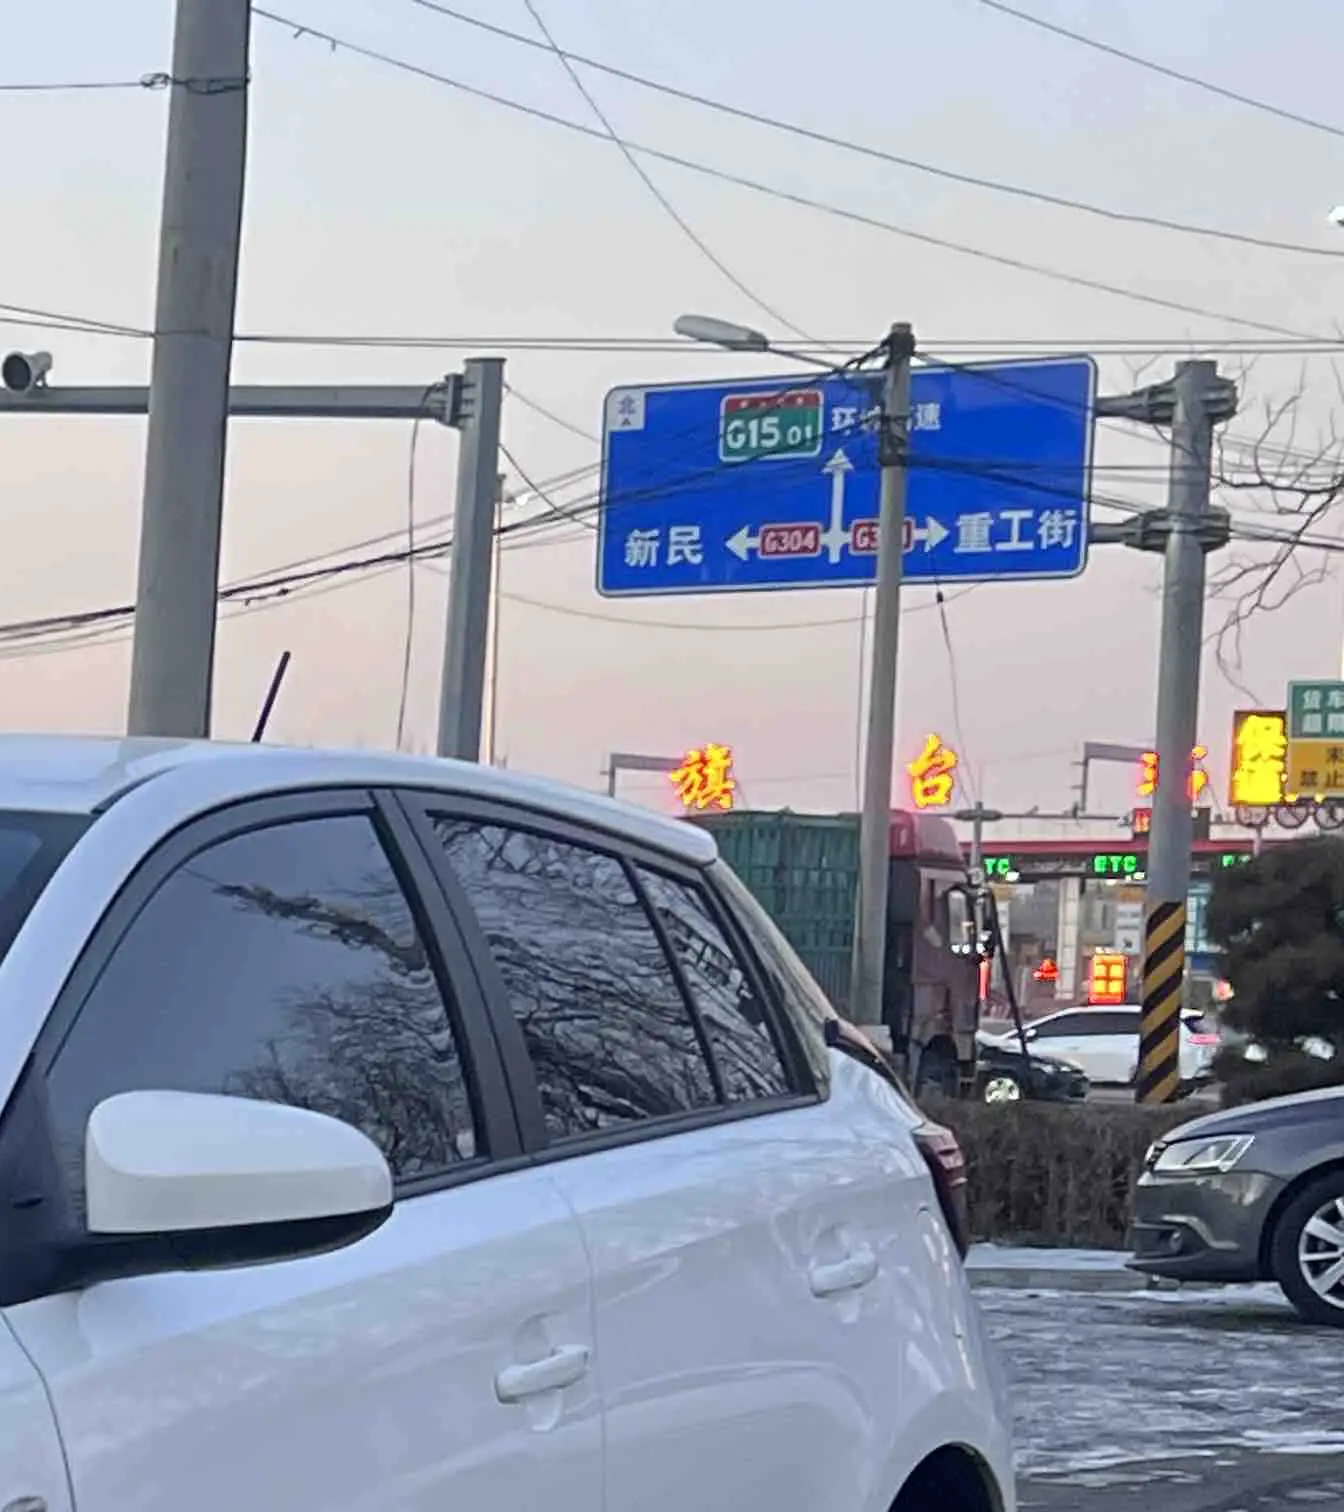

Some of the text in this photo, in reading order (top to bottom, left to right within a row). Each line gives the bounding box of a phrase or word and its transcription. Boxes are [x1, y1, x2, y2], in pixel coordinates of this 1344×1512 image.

[624, 525, 704, 567] 新民
[764, 530, 816, 552] G304
[953, 509, 1077, 553] 重工街
[1093, 855, 1137, 873] ETC
